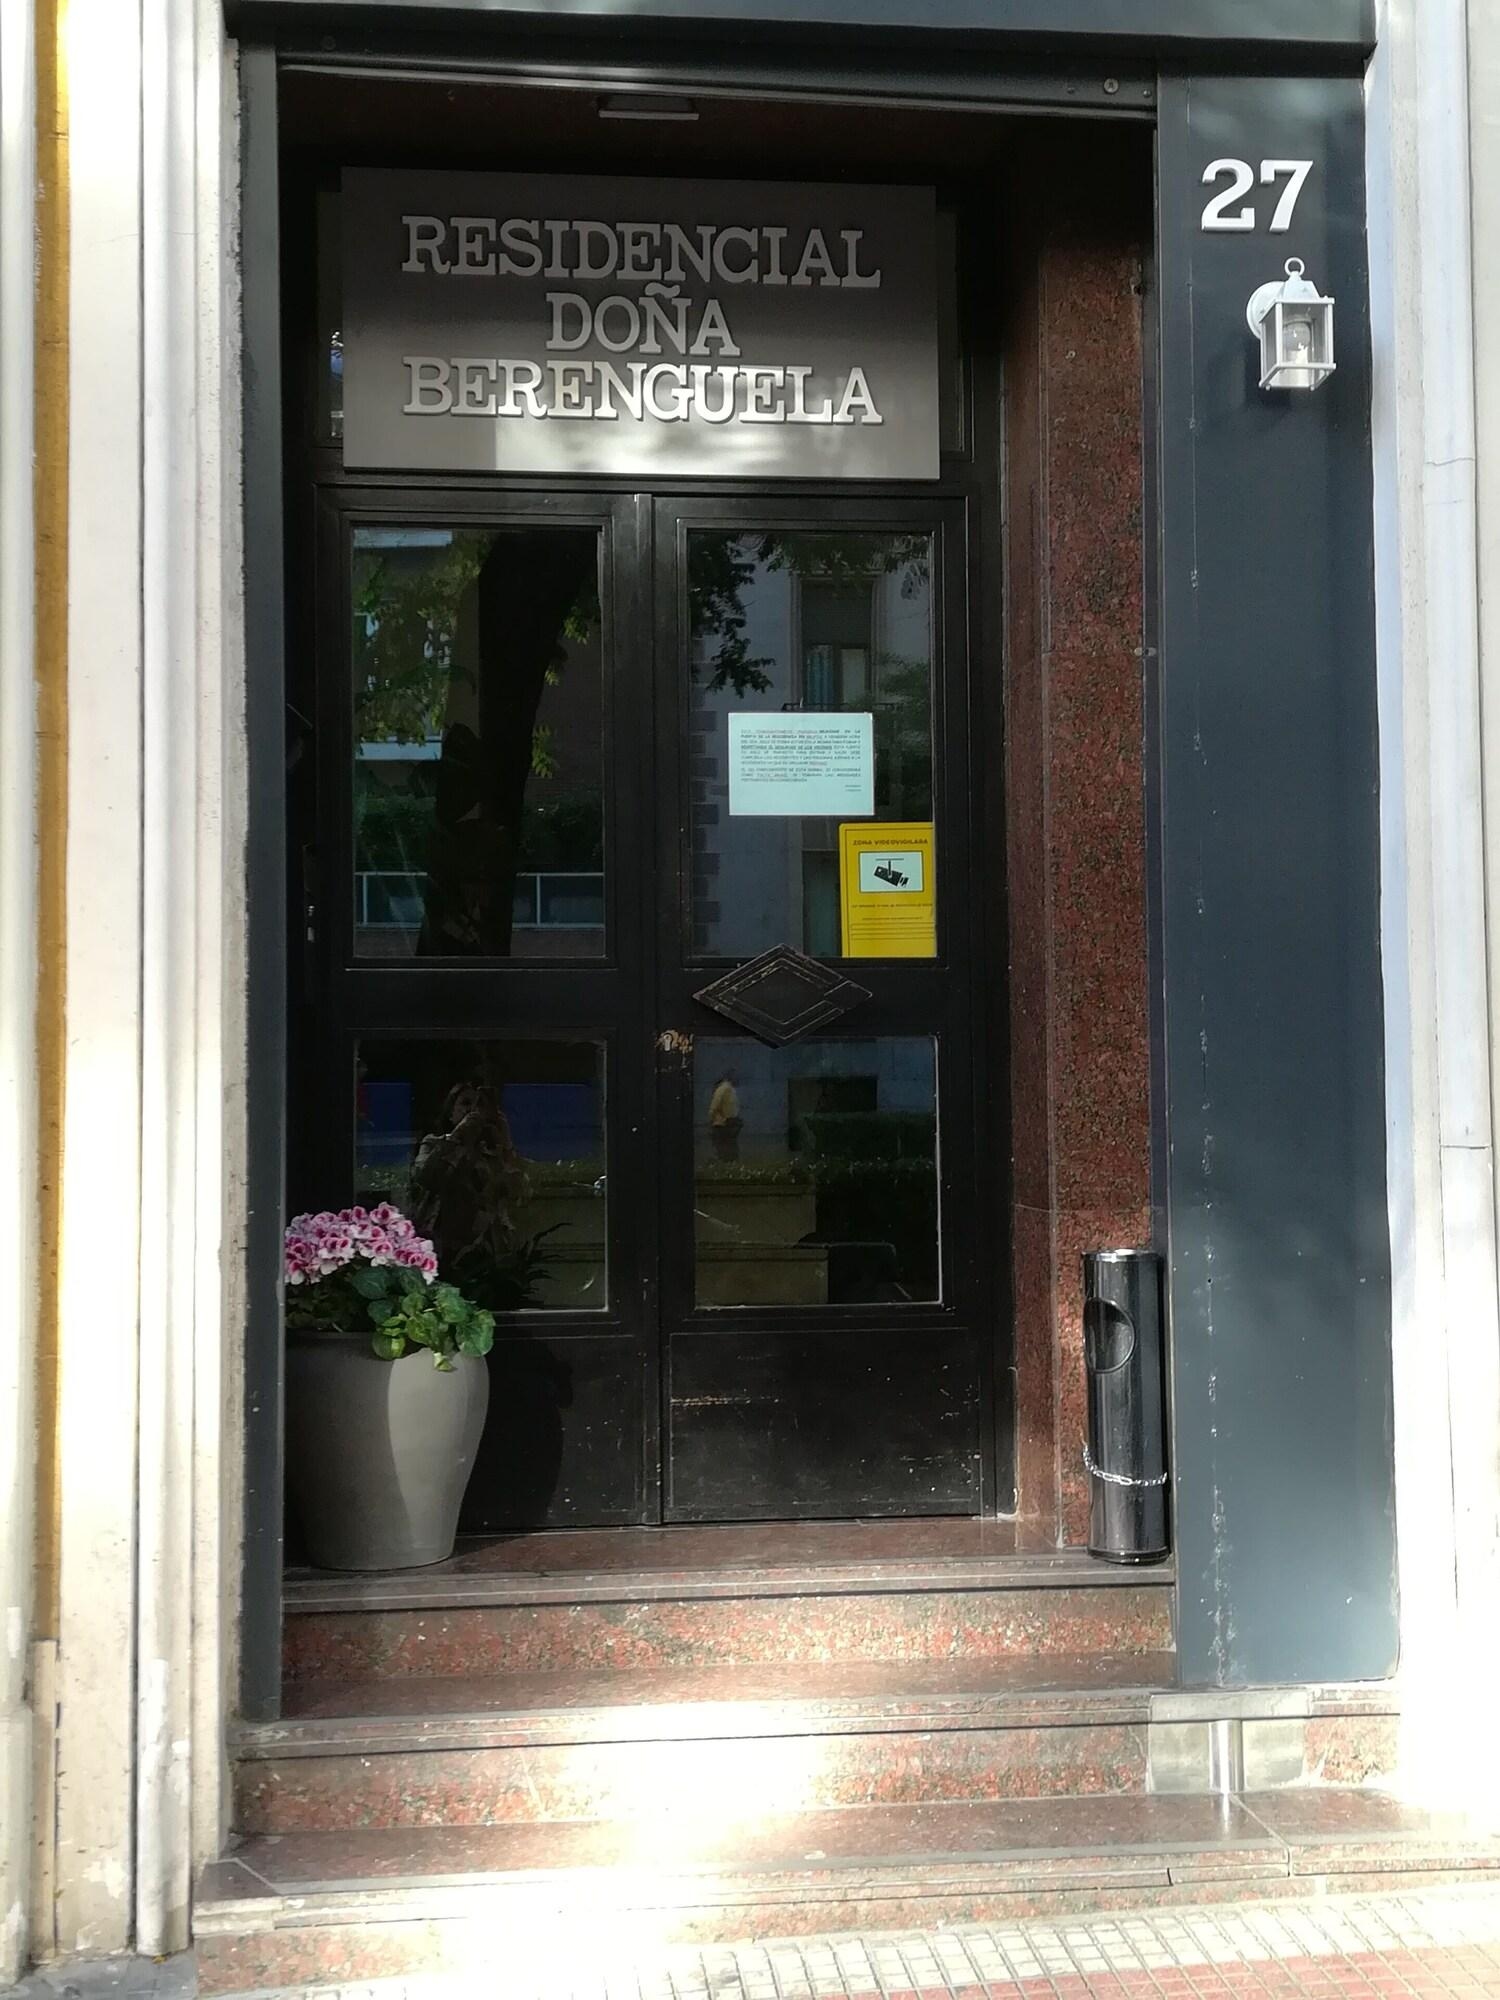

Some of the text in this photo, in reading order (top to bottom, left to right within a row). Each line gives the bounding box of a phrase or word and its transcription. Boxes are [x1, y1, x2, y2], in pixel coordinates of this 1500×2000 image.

[1201, 158, 1314, 233] 27
[402, 215, 881, 288] RESIDENCIAL
[546, 282, 741, 357] DOÑA
[403, 356, 884, 425] BERENGUELA
